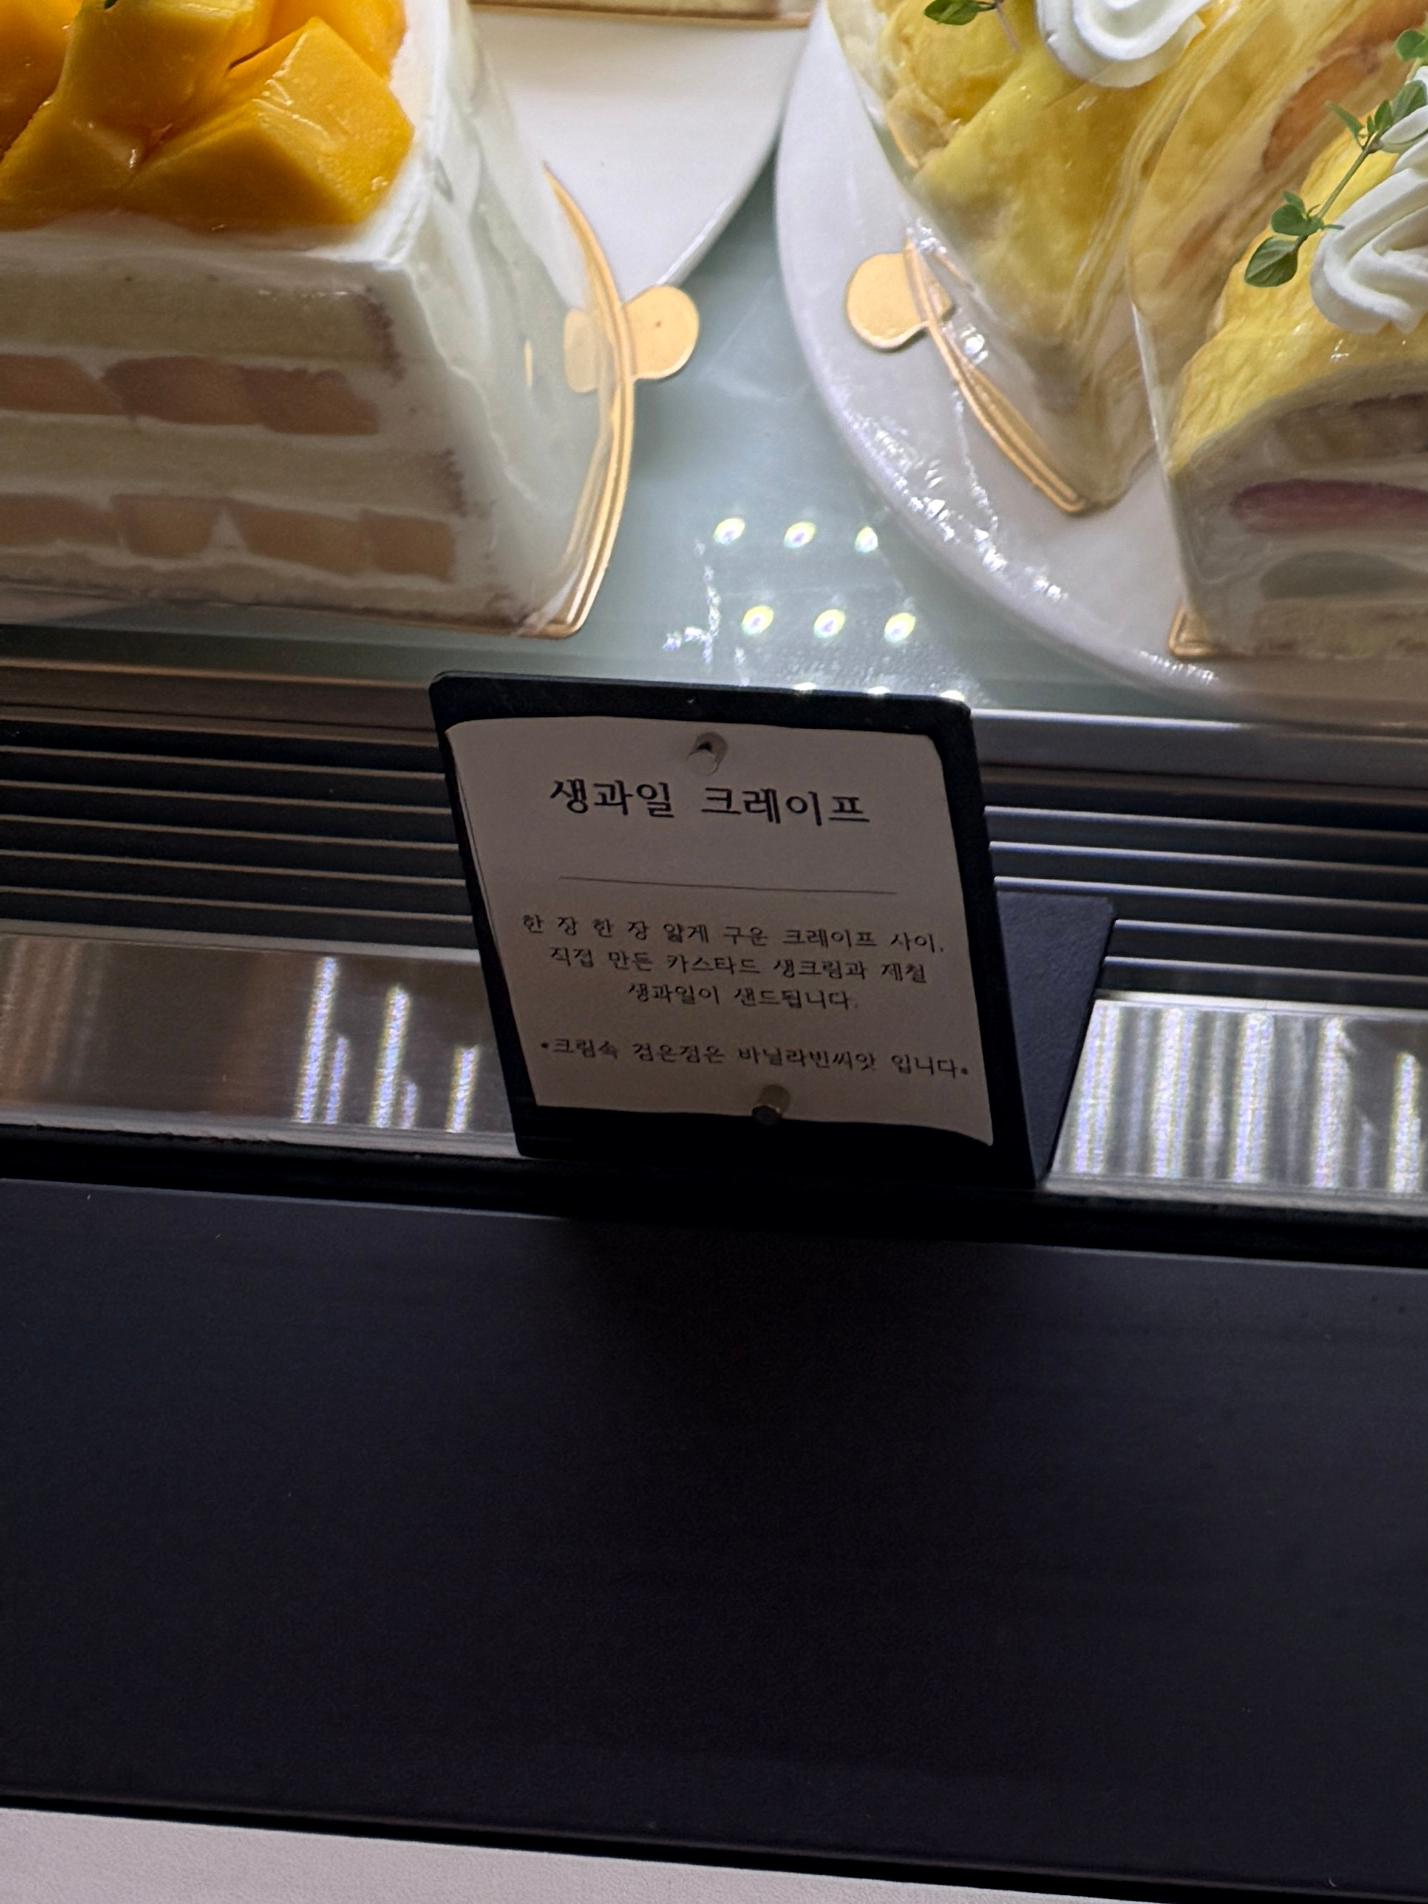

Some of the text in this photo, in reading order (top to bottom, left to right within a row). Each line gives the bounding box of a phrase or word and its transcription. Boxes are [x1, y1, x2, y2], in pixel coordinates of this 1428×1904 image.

[549, 778, 871, 827] 생과일 크레이프
[522, 913, 545, 935] 한
[557, 916, 578, 937] 장
[591, 917, 615, 939] 한
[627, 920, 649, 941] 장
[722, 925, 769, 948] 구운
[782, 927, 878, 949] 크레이프
[550, 946, 927, 984] 직접 만든 카스타드 생크림과 제철
[627, 983, 720, 1006] 생과일이
[631, 1042, 725, 1064] 검은점은
[737, 1045, 876, 1072] 바닐라빈씨앗
